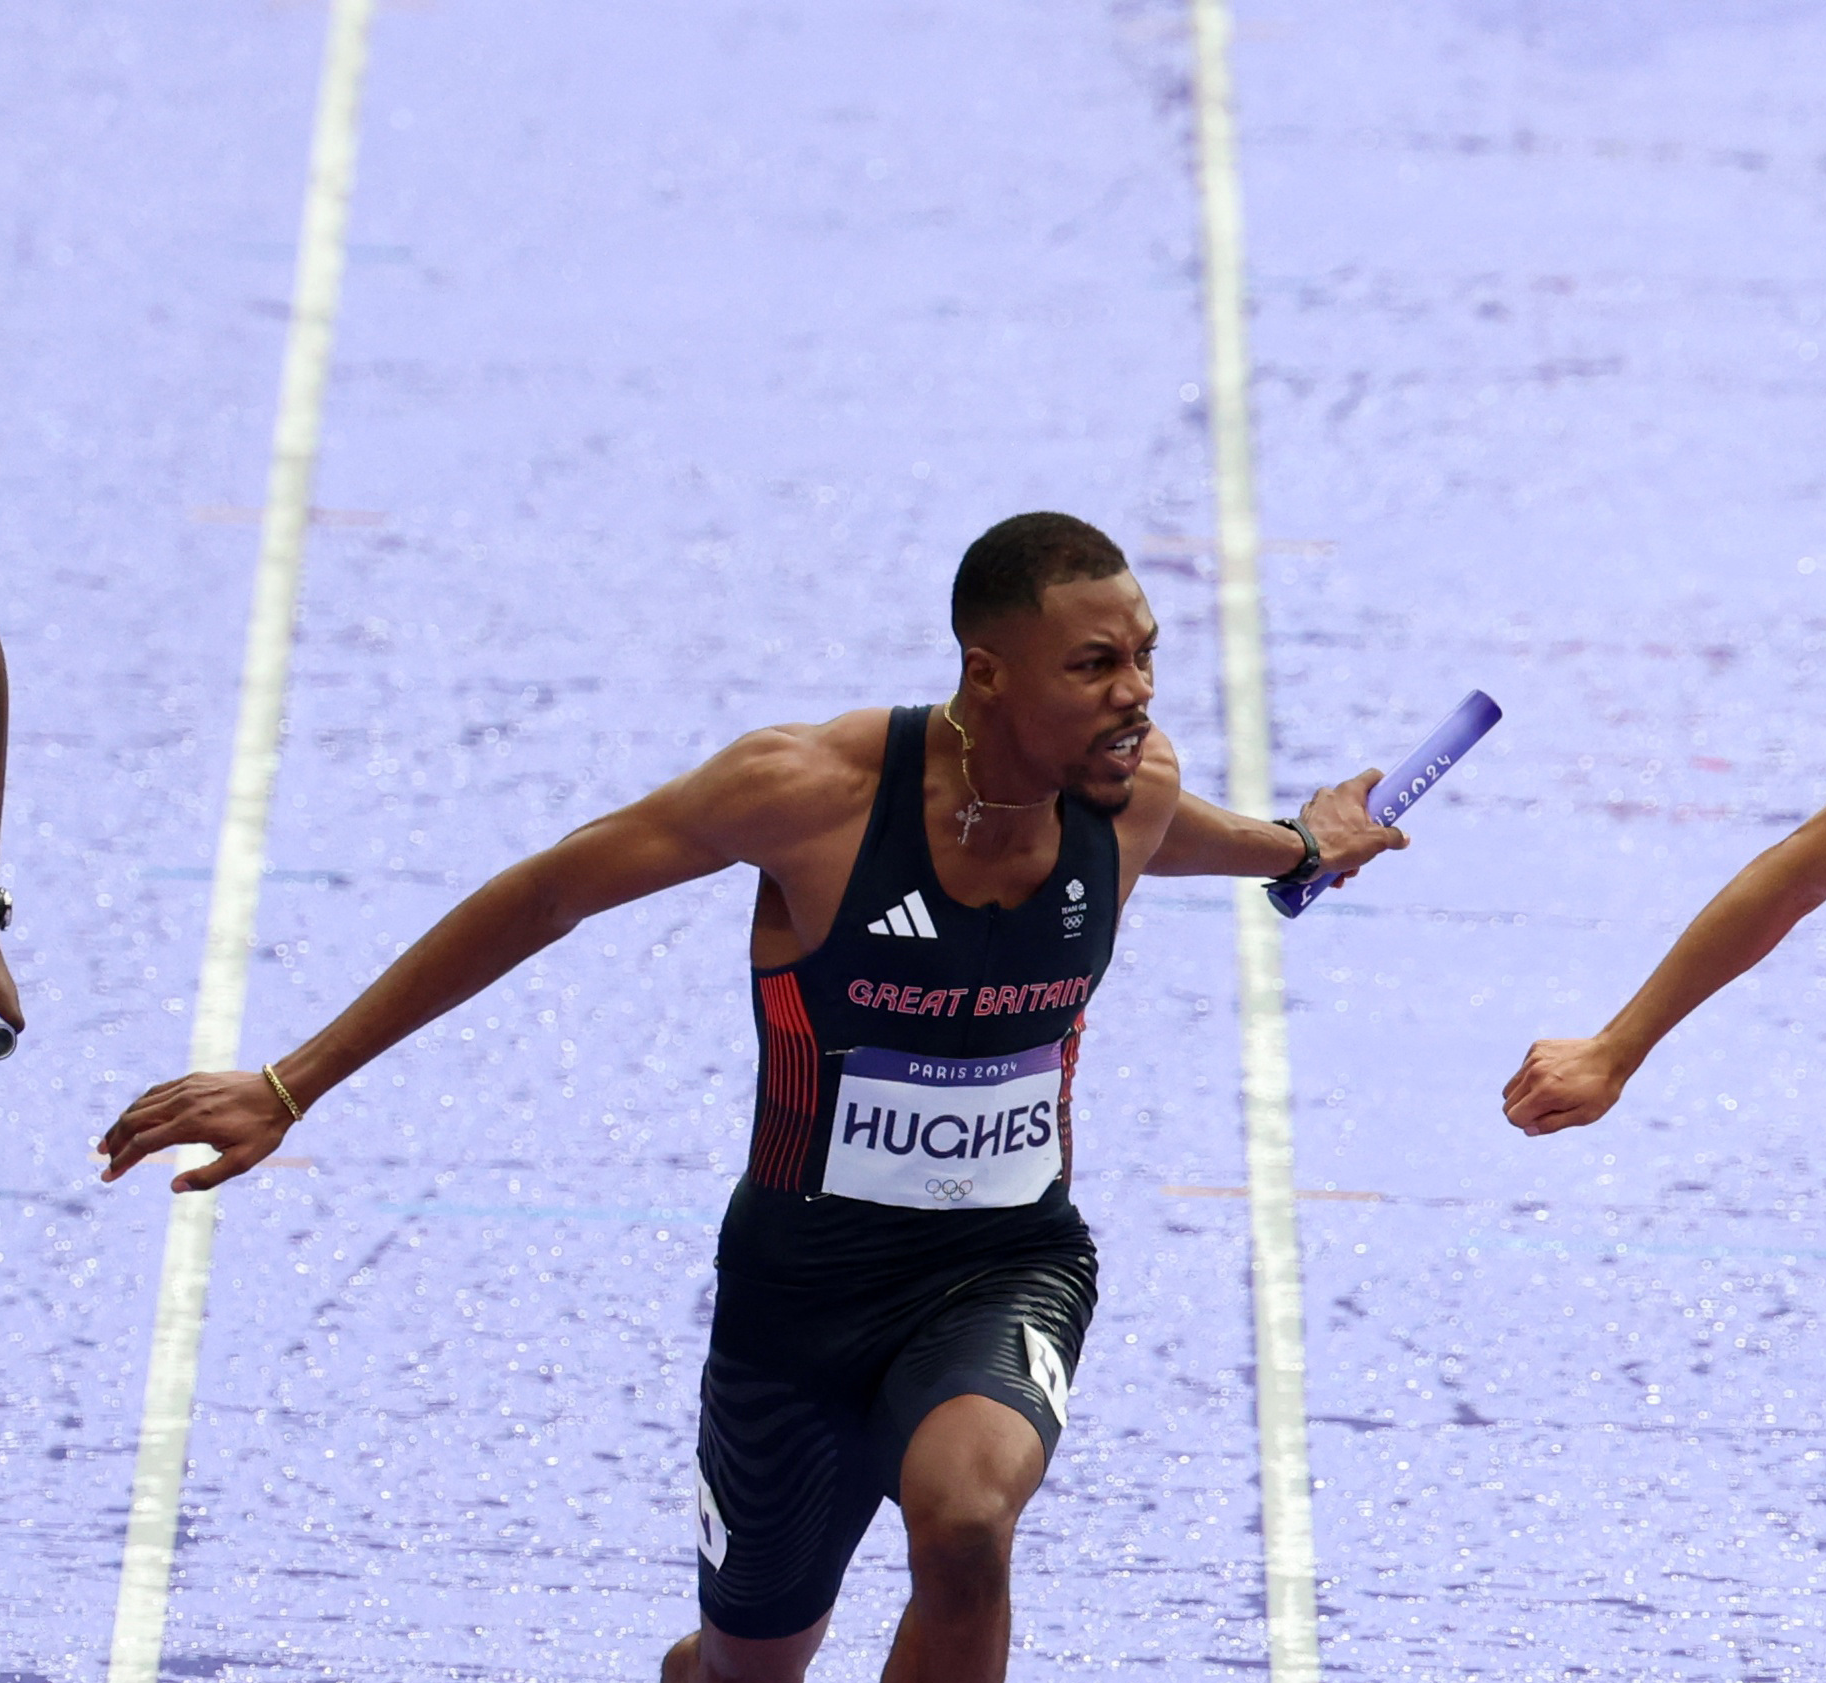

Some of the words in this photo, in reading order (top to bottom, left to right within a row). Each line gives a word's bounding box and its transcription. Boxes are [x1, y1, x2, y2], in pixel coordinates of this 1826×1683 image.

[1399, 754, 1452, 807] 2024
[848, 979, 969, 1017] GREAT
[974, 974, 1093, 1017] BRITAIN
[909, 1061, 967, 1079] PARIS
[974, 1061, 1018, 1079] 2024
[842, 1100, 1051, 1160] HUGHES
